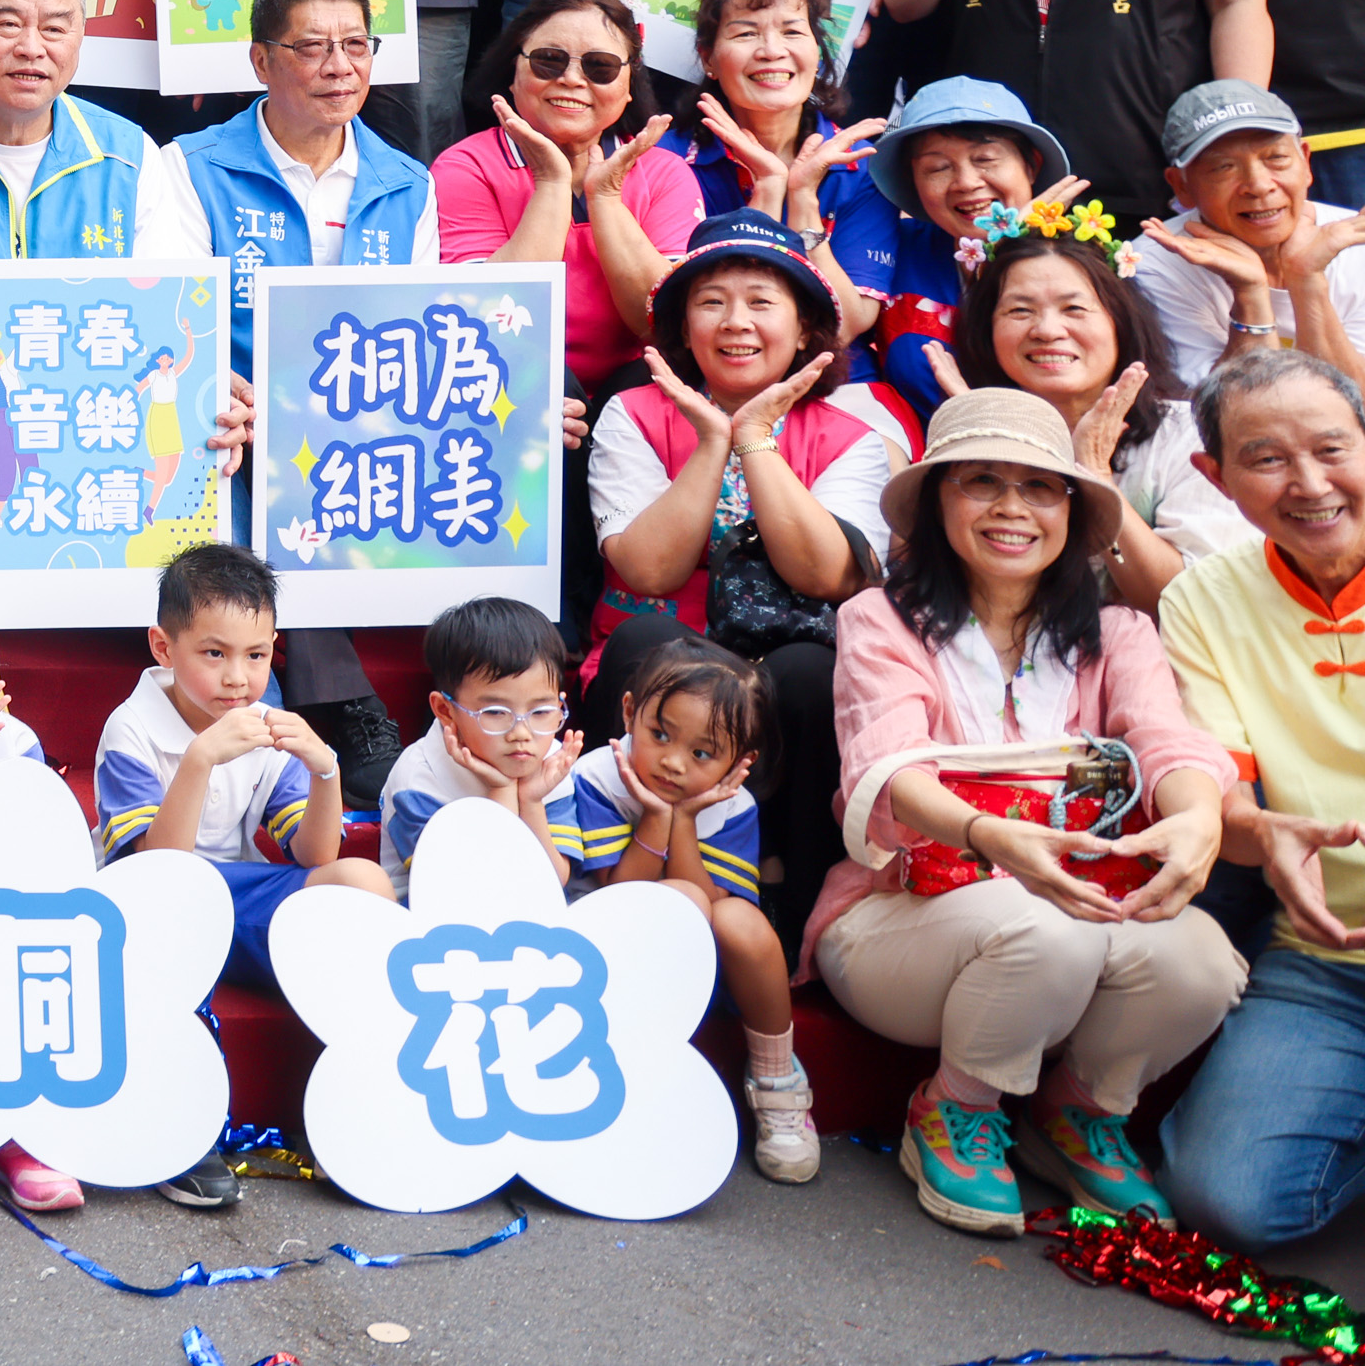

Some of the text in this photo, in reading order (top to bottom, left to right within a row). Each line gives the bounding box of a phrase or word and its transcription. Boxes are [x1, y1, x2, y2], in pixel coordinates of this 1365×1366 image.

[1193, 104, 1237, 131] Mobil
[81, 224, 113, 251] 林
[269, 211, 286, 242] 特助
[731, 223, 774, 237] YIMIN
[8, 302, 142, 369] 青春
[314, 309, 504, 425] 桐為
[8, 386, 142, 451] 音樂
[7, 468, 142, 533] 永續
[315, 433, 498, 542] 網美
[399, 934, 612, 1131] 花
